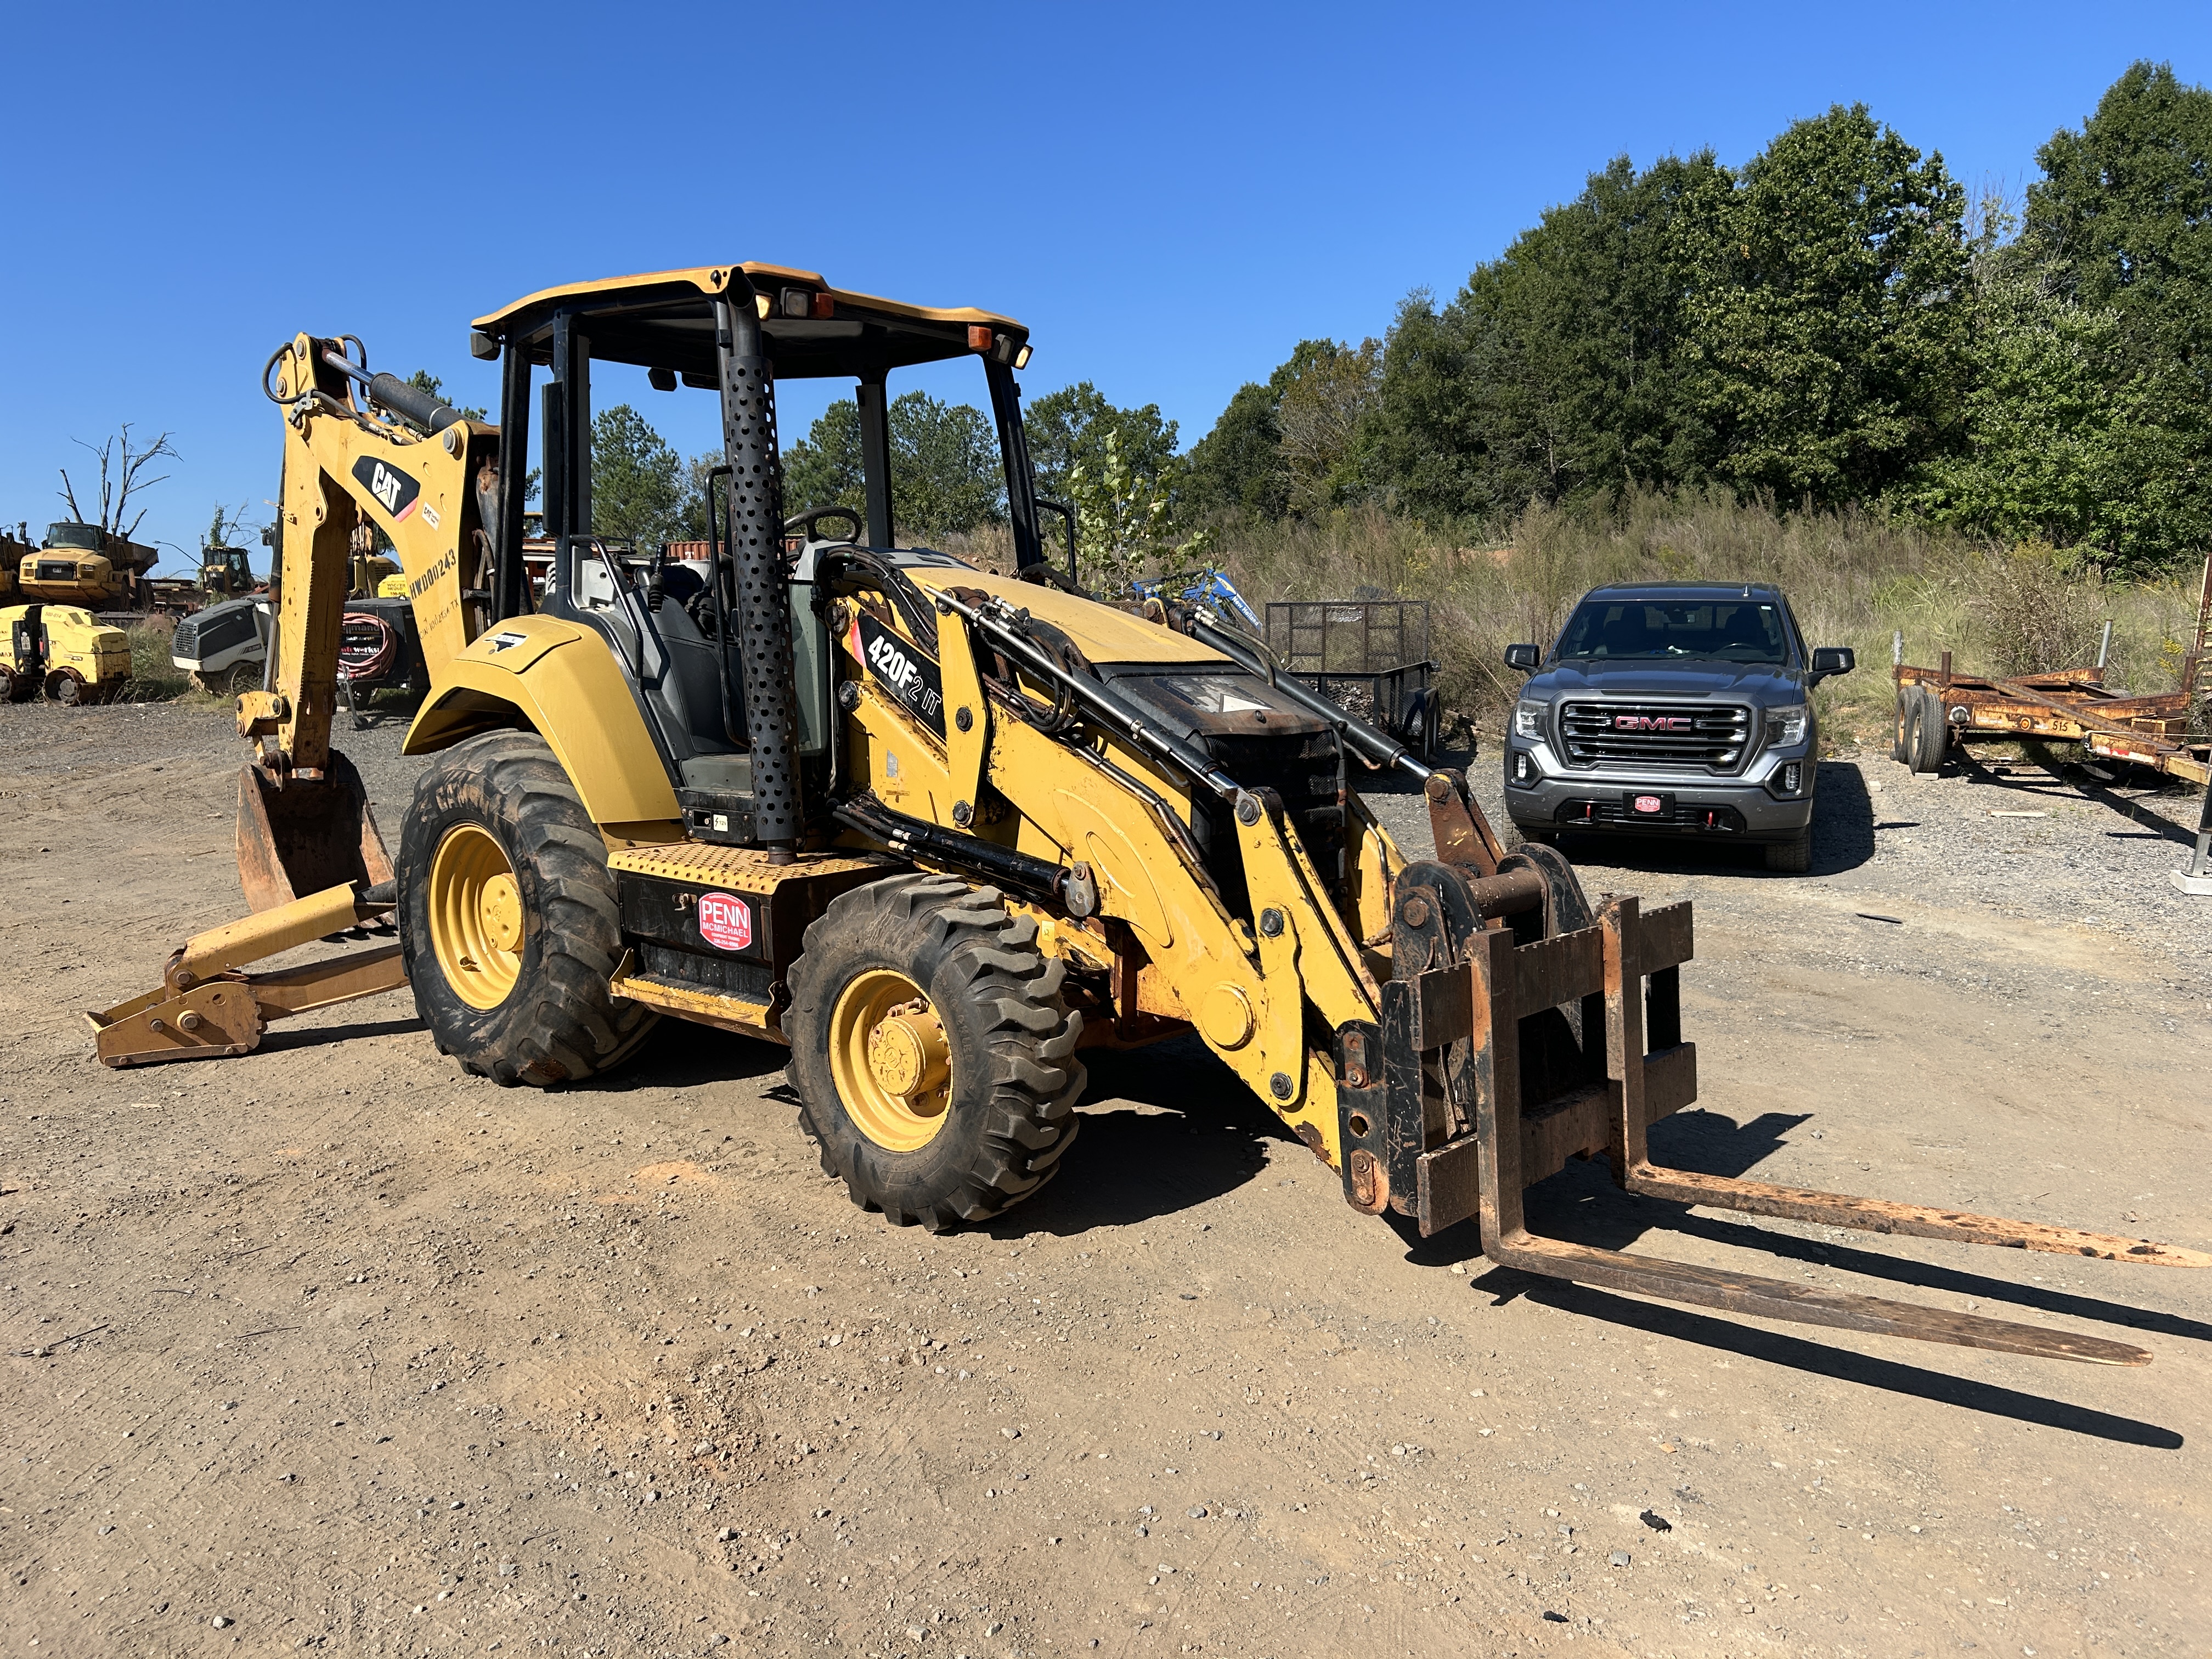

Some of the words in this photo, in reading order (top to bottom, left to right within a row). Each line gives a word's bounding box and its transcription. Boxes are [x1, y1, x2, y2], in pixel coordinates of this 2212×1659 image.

[371, 462, 402, 512] CAT
[424, 506, 432, 519] CAT
[409, 548, 456, 600] HWD00243
[1232, 596, 1243, 610] New
[1242, 606, 1260, 627] Holland
[921, 687, 942, 716] IT
[1615, 715, 1691, 731] GMC
[2052, 720, 2069, 732] 515
[702, 900, 748, 929] PENN
[703, 922, 748, 938] MCMICHAEL
